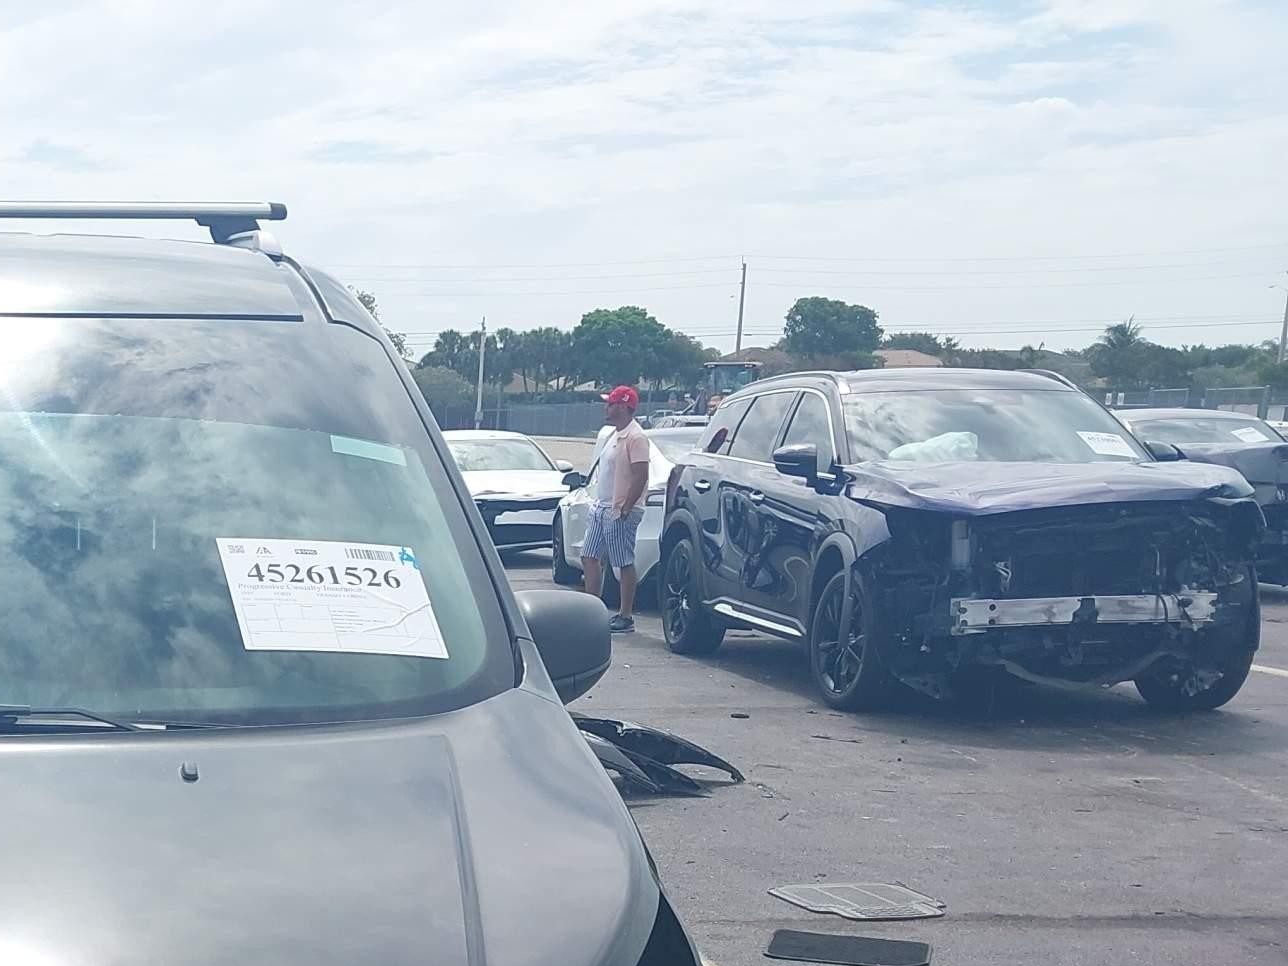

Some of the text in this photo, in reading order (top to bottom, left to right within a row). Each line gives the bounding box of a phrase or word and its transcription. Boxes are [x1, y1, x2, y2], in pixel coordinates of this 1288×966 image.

[247, 562, 401, 589] 45261526
[238, 583, 284, 591] Progressive
[286, 584, 321, 593] Casualty
